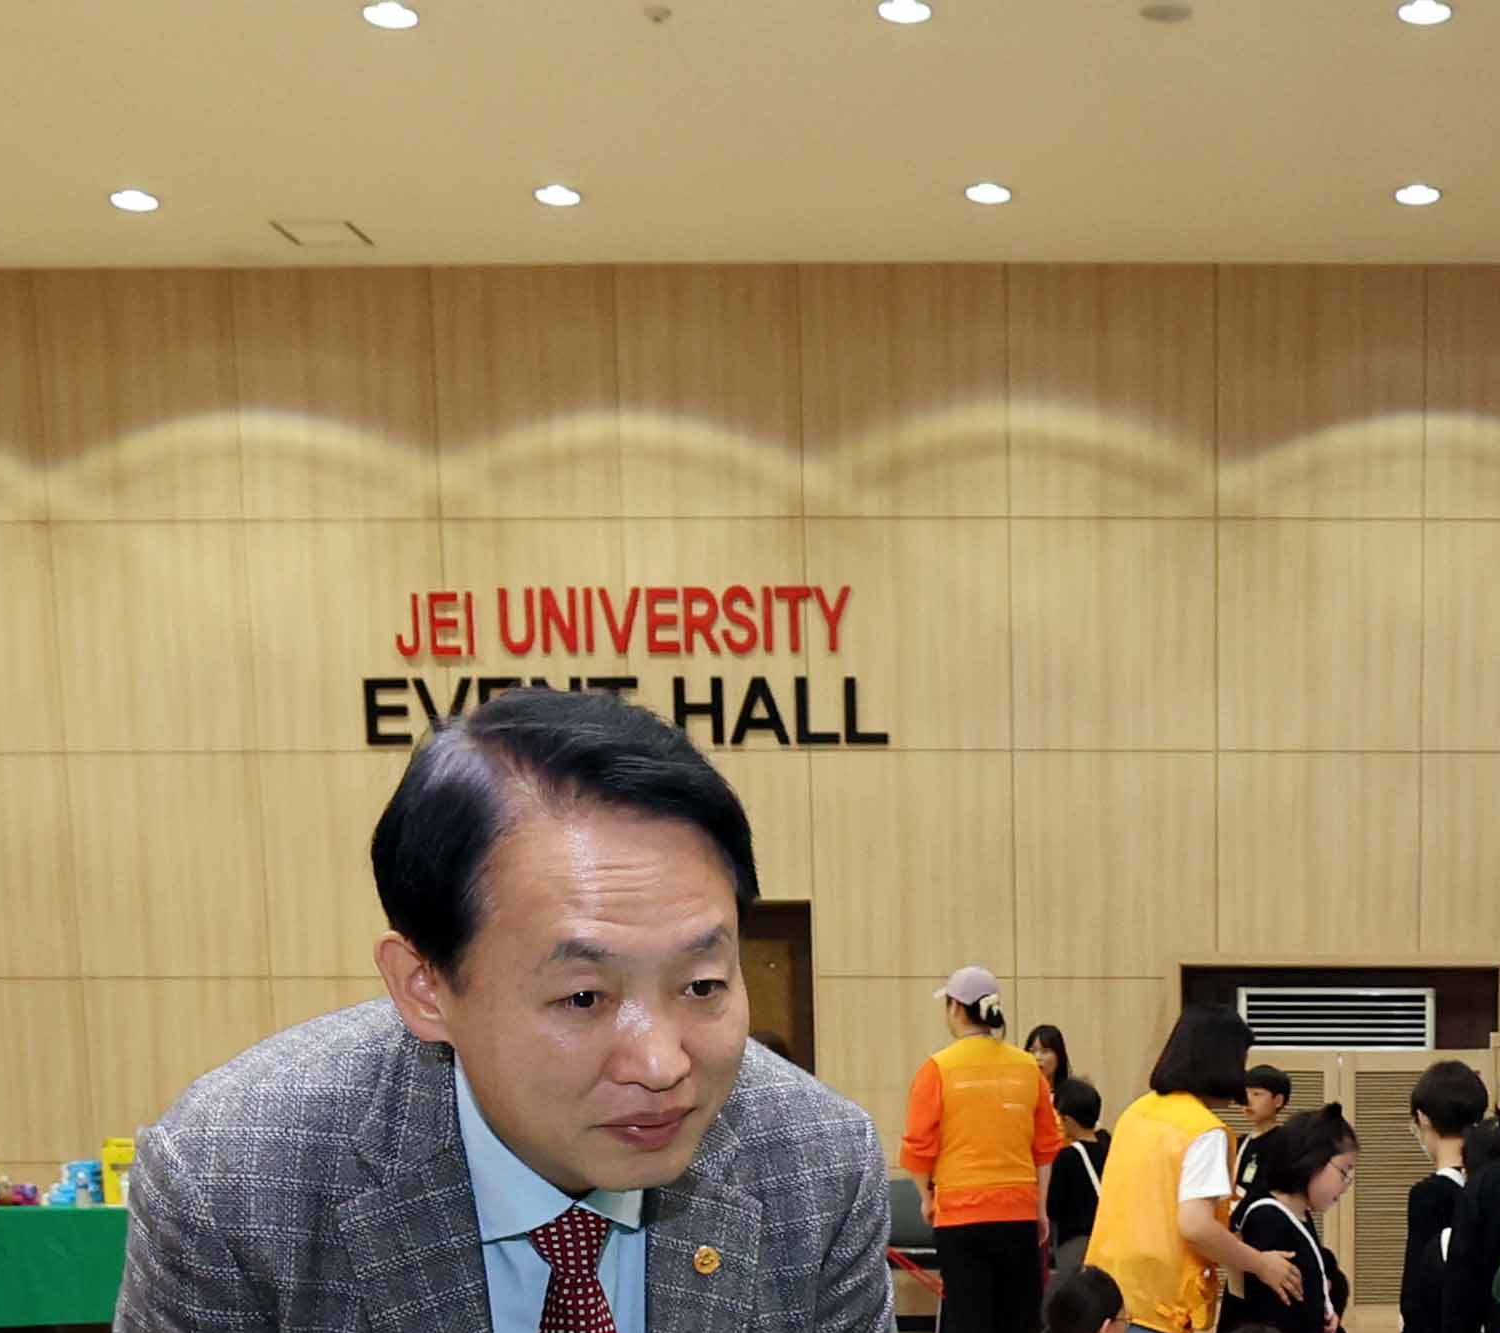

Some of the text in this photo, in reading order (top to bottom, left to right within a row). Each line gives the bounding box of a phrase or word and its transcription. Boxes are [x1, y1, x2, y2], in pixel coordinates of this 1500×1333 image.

[396, 585, 851, 657] JEI UNIVERSITY
[672, 676, 889, 746] HALL
